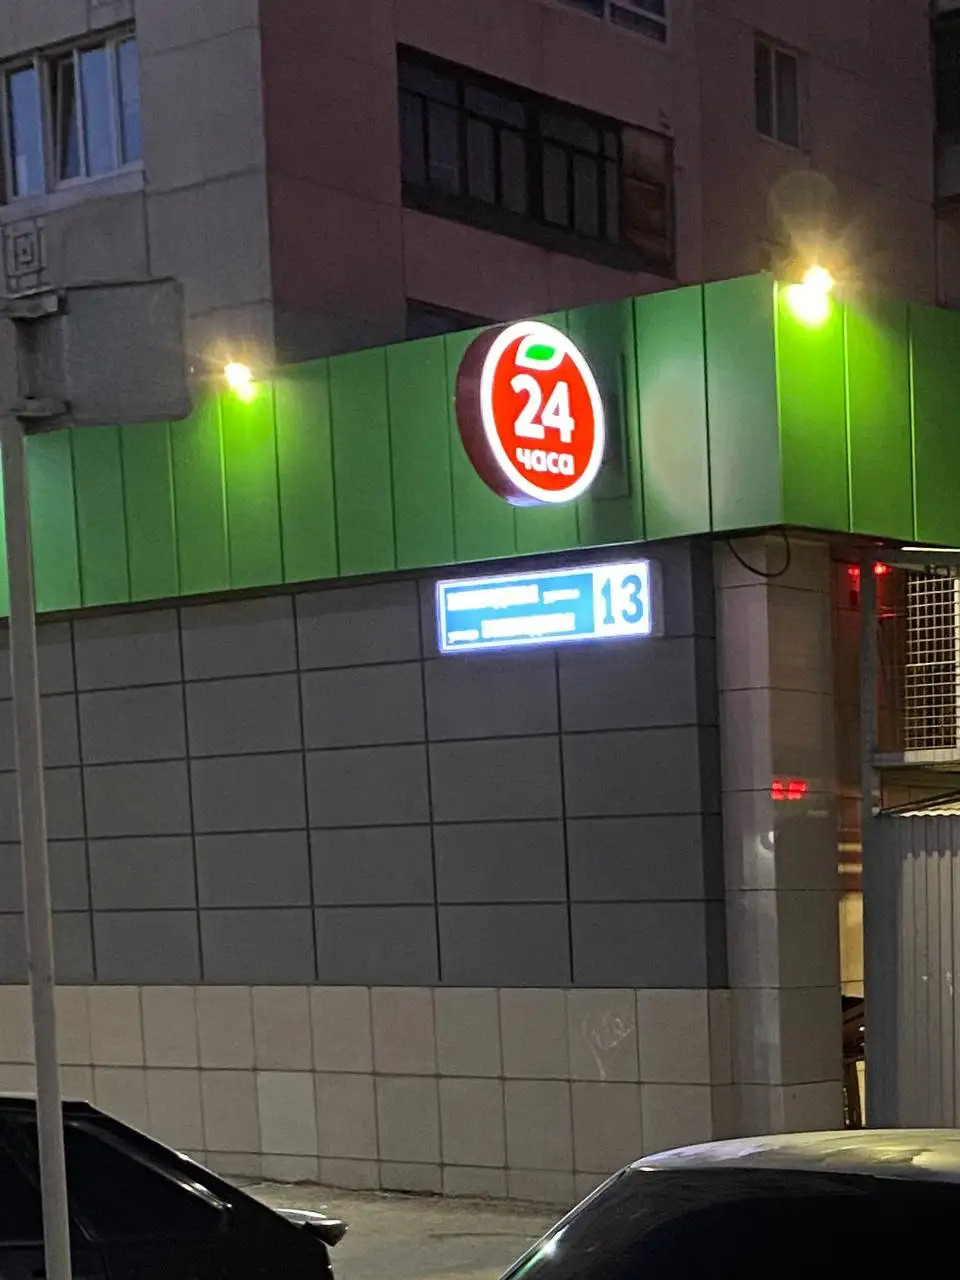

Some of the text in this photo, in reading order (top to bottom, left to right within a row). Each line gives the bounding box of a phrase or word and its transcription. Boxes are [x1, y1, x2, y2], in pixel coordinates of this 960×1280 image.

[510, 374, 574, 443] 24
[515, 448, 574, 476] часа
[600, 574, 644, 625] 13
